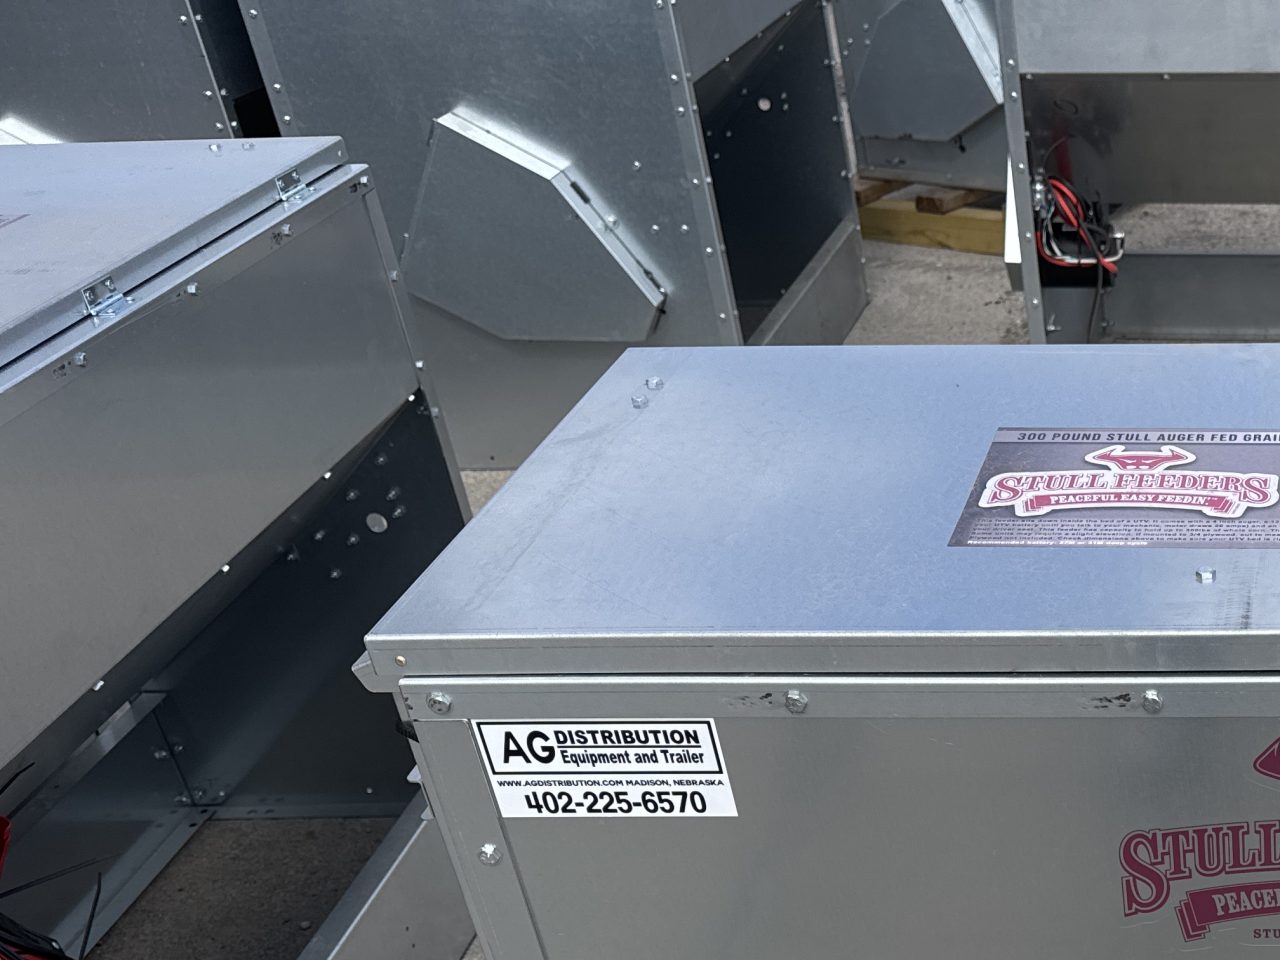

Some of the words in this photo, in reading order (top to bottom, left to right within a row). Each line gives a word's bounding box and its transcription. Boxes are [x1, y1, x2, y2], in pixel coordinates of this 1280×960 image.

[1017, 433, 1048, 441] 300
[1052, 433, 1101, 442] POUND
[1106, 434, 1152, 442] STULL
[1156, 434, 1205, 442] AUGER
[1210, 434, 1238, 442] FED
[988, 473, 1108, 504] STULL
[1112, 473, 1271, 504] FEEDERS
[1051, 494, 1118, 504] PEACEFUL
[554, 730, 701, 745] DISTRIBUTION
[502, 730, 556, 764] AG
[560, 750, 632, 768] Equipment
[635, 750, 658, 764] and
[660, 750, 704, 764] Trailer
[524, 790, 708, 814] 402-225-6570
